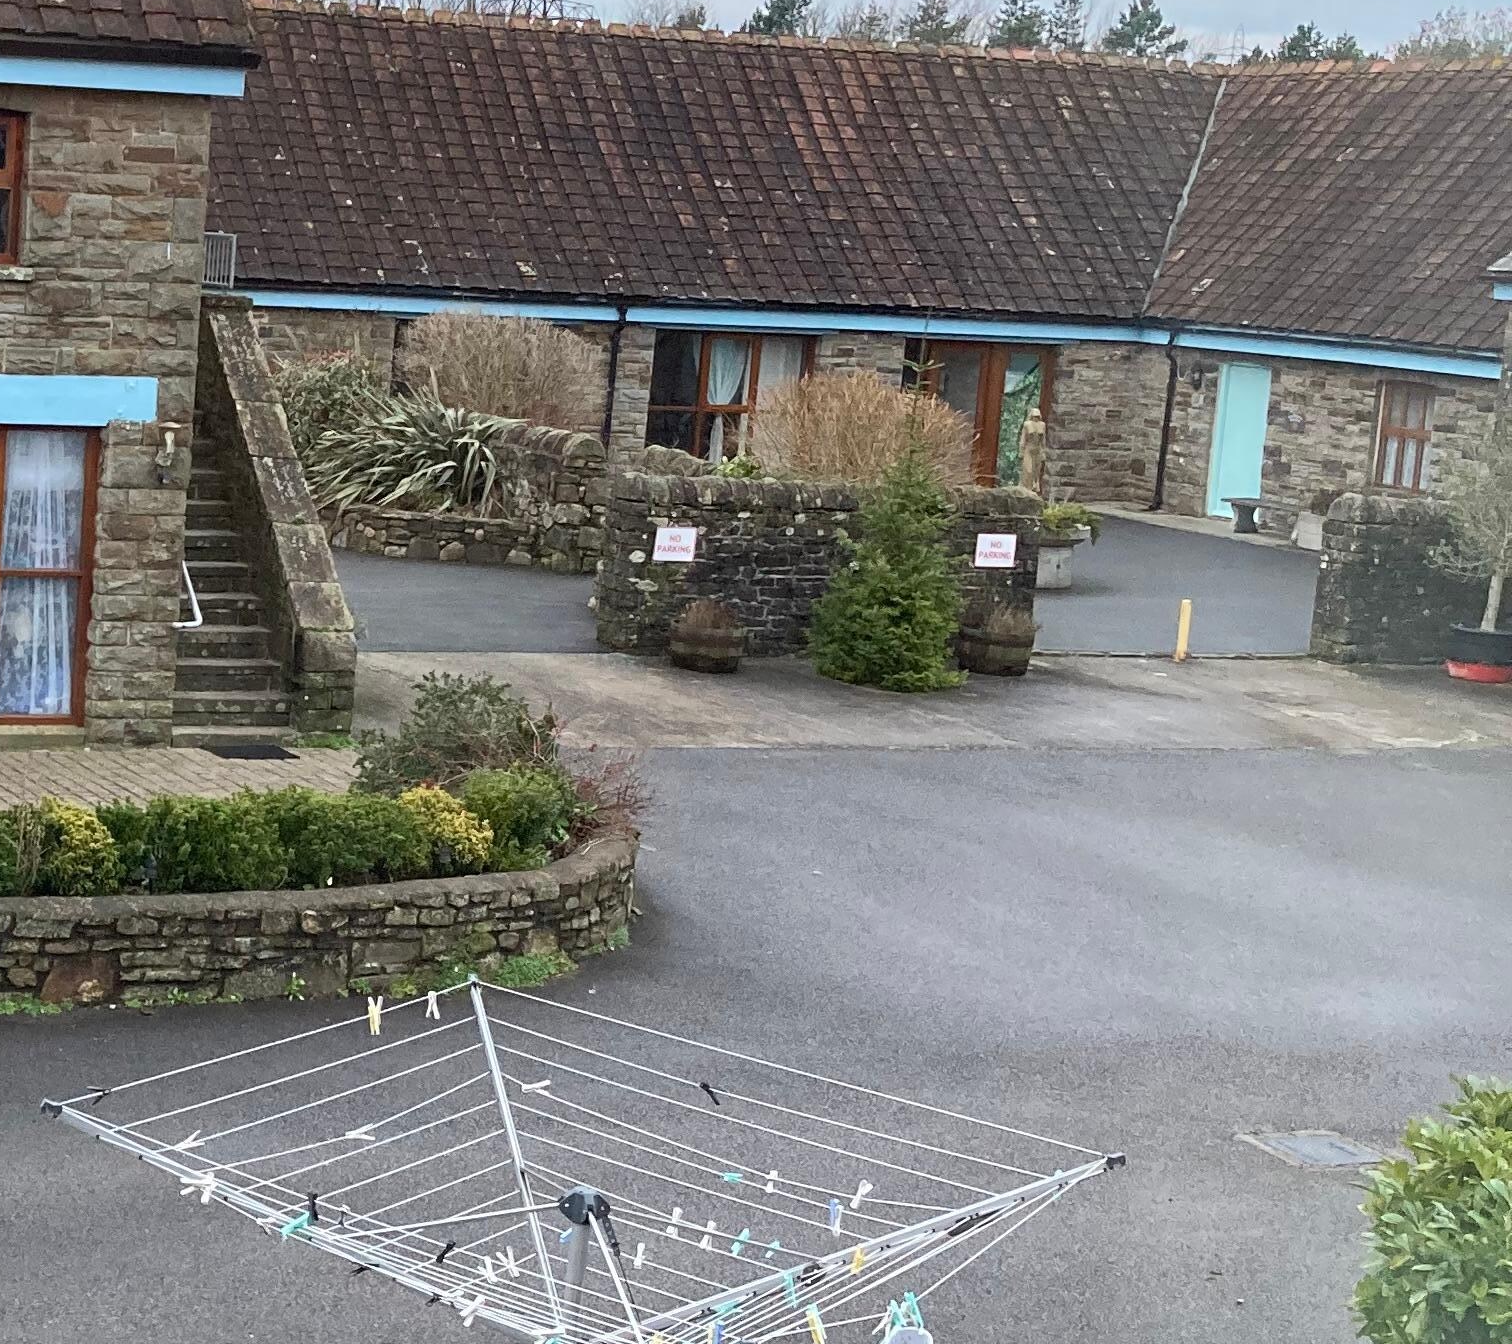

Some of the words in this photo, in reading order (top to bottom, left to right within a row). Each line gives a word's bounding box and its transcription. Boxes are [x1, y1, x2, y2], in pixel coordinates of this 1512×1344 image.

[669, 535, 682, 543] NO
[990, 540, 1002, 549] NO
[657, 545, 691, 554] PARKING
[978, 551, 1012, 560] PARKING
